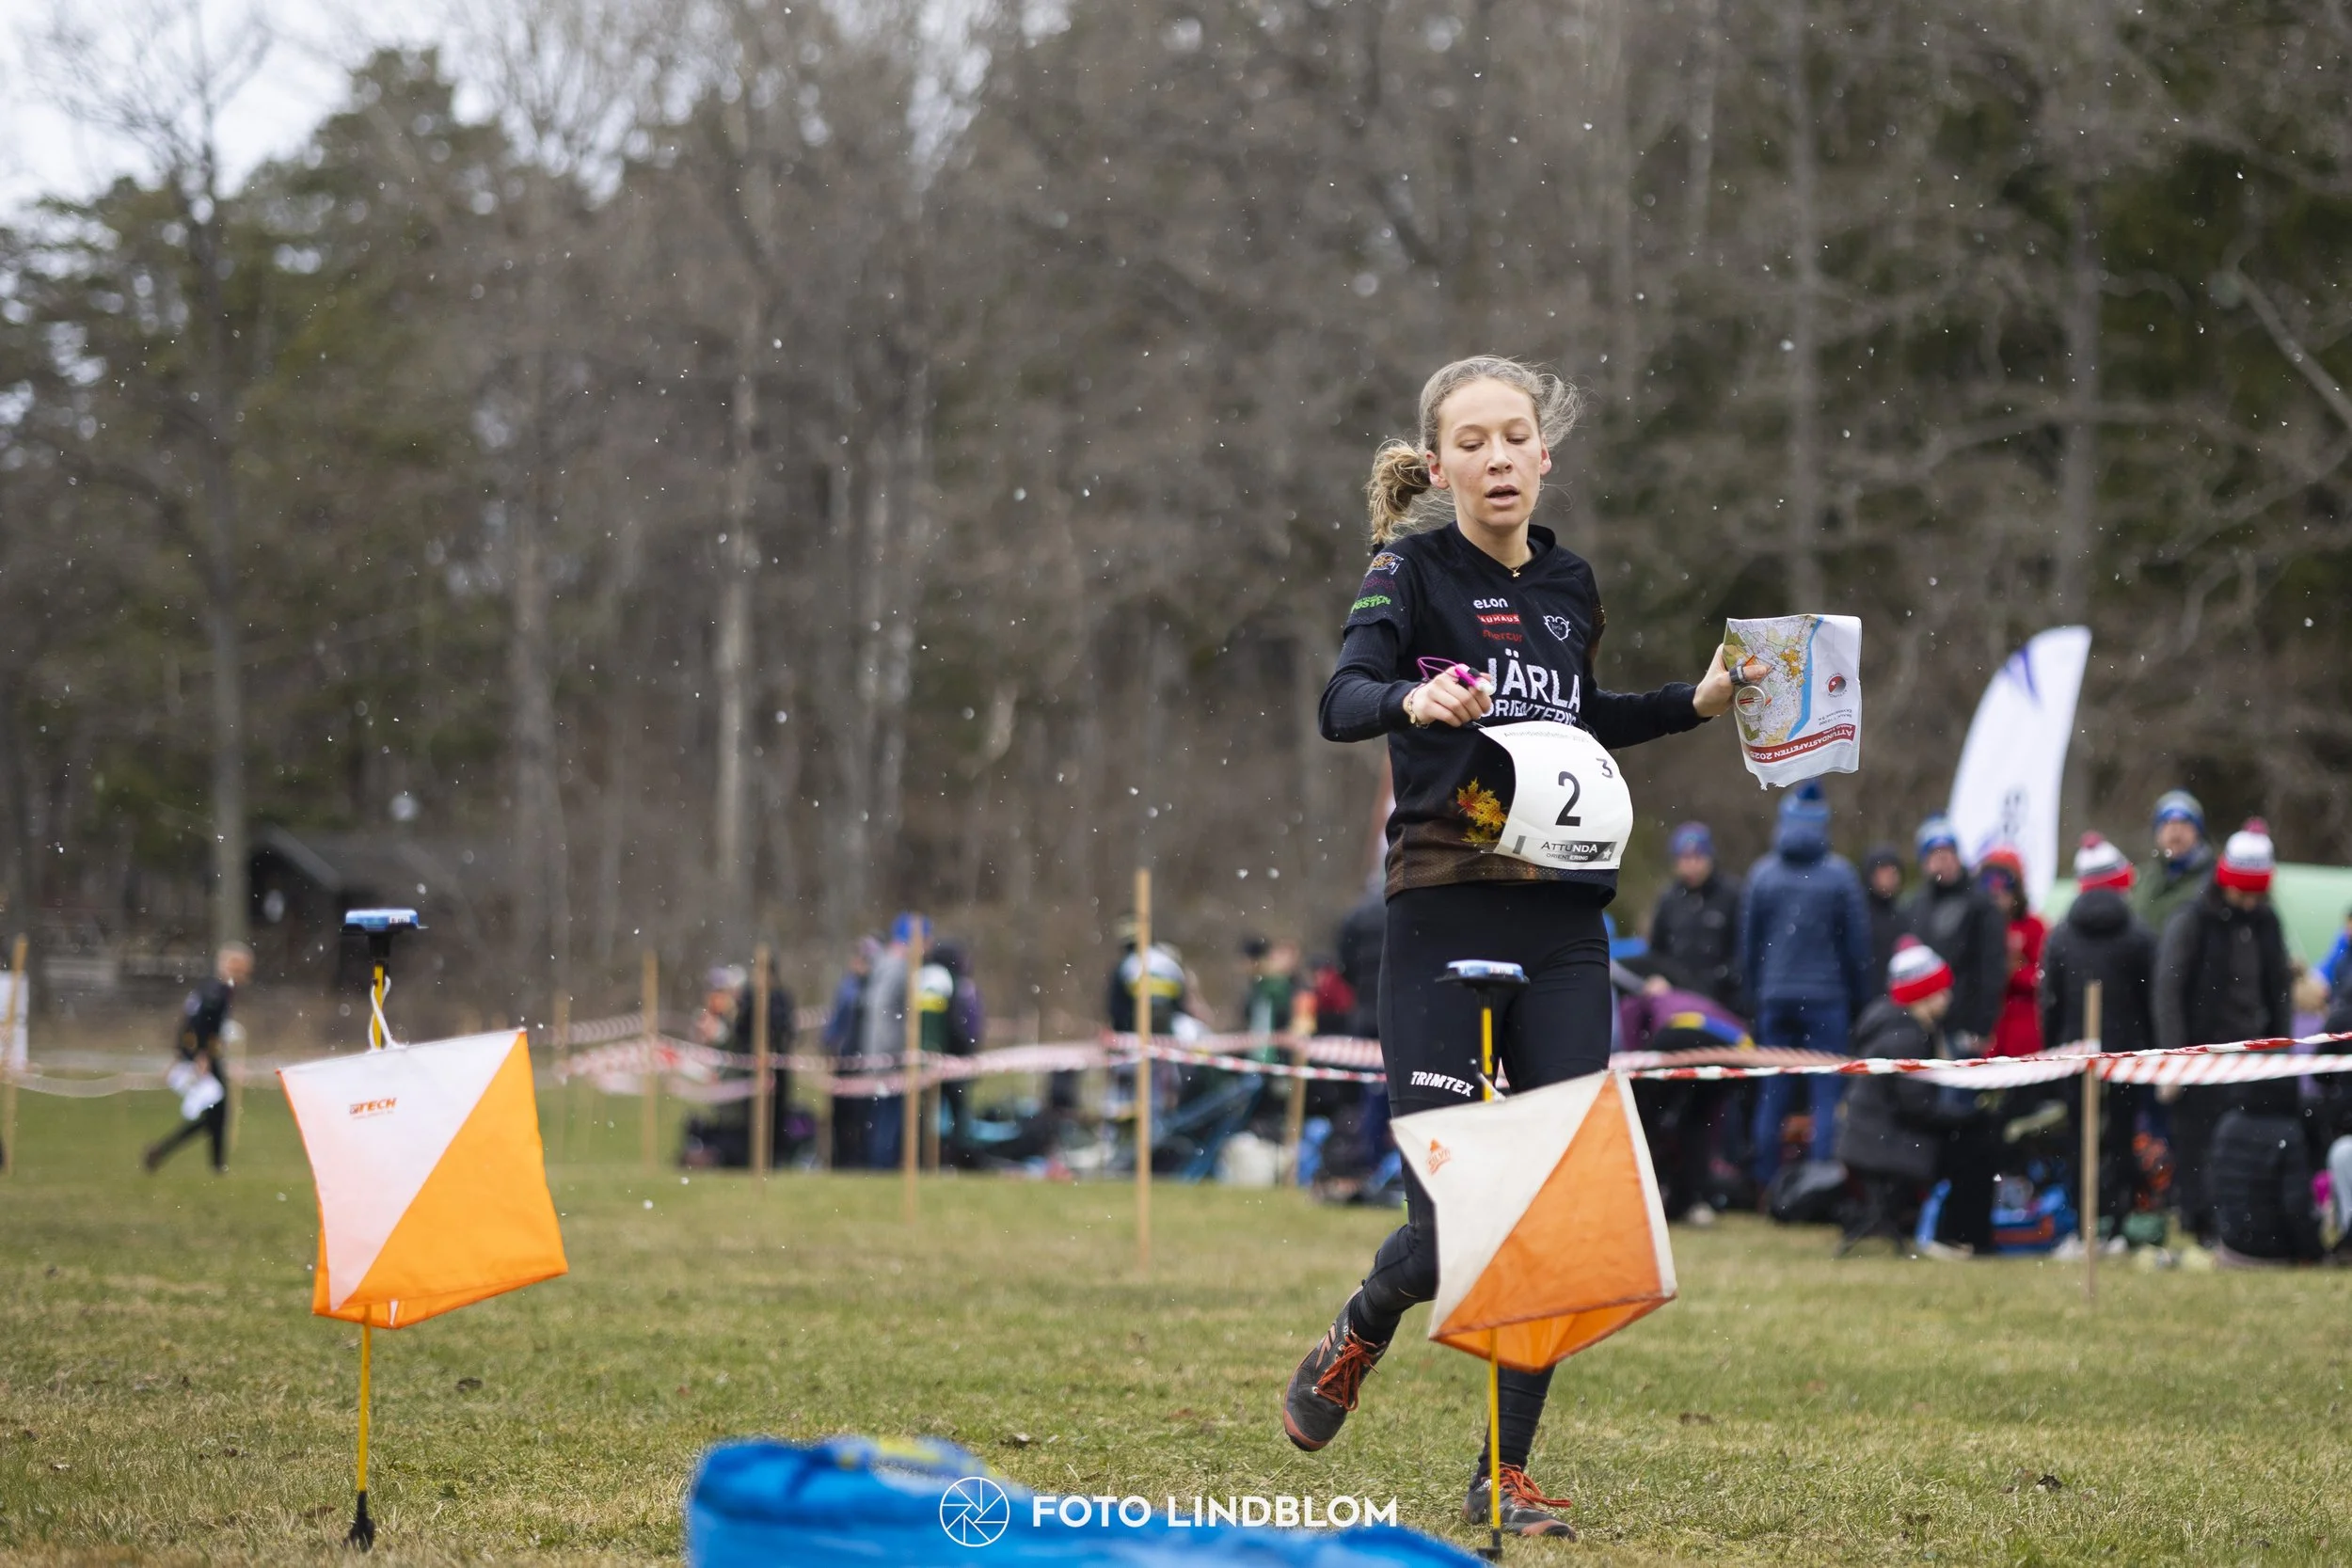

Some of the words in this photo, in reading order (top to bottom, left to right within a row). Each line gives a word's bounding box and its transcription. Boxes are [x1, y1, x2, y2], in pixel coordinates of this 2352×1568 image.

[1487, 648, 1581, 713] JÄRLA
[1596, 757, 1613, 779] 3
[1555, 770, 1581, 827] 2
[1541, 841, 1598, 853] ATTUNDA
[1410, 1071, 1475, 1097] TRIMTEX
